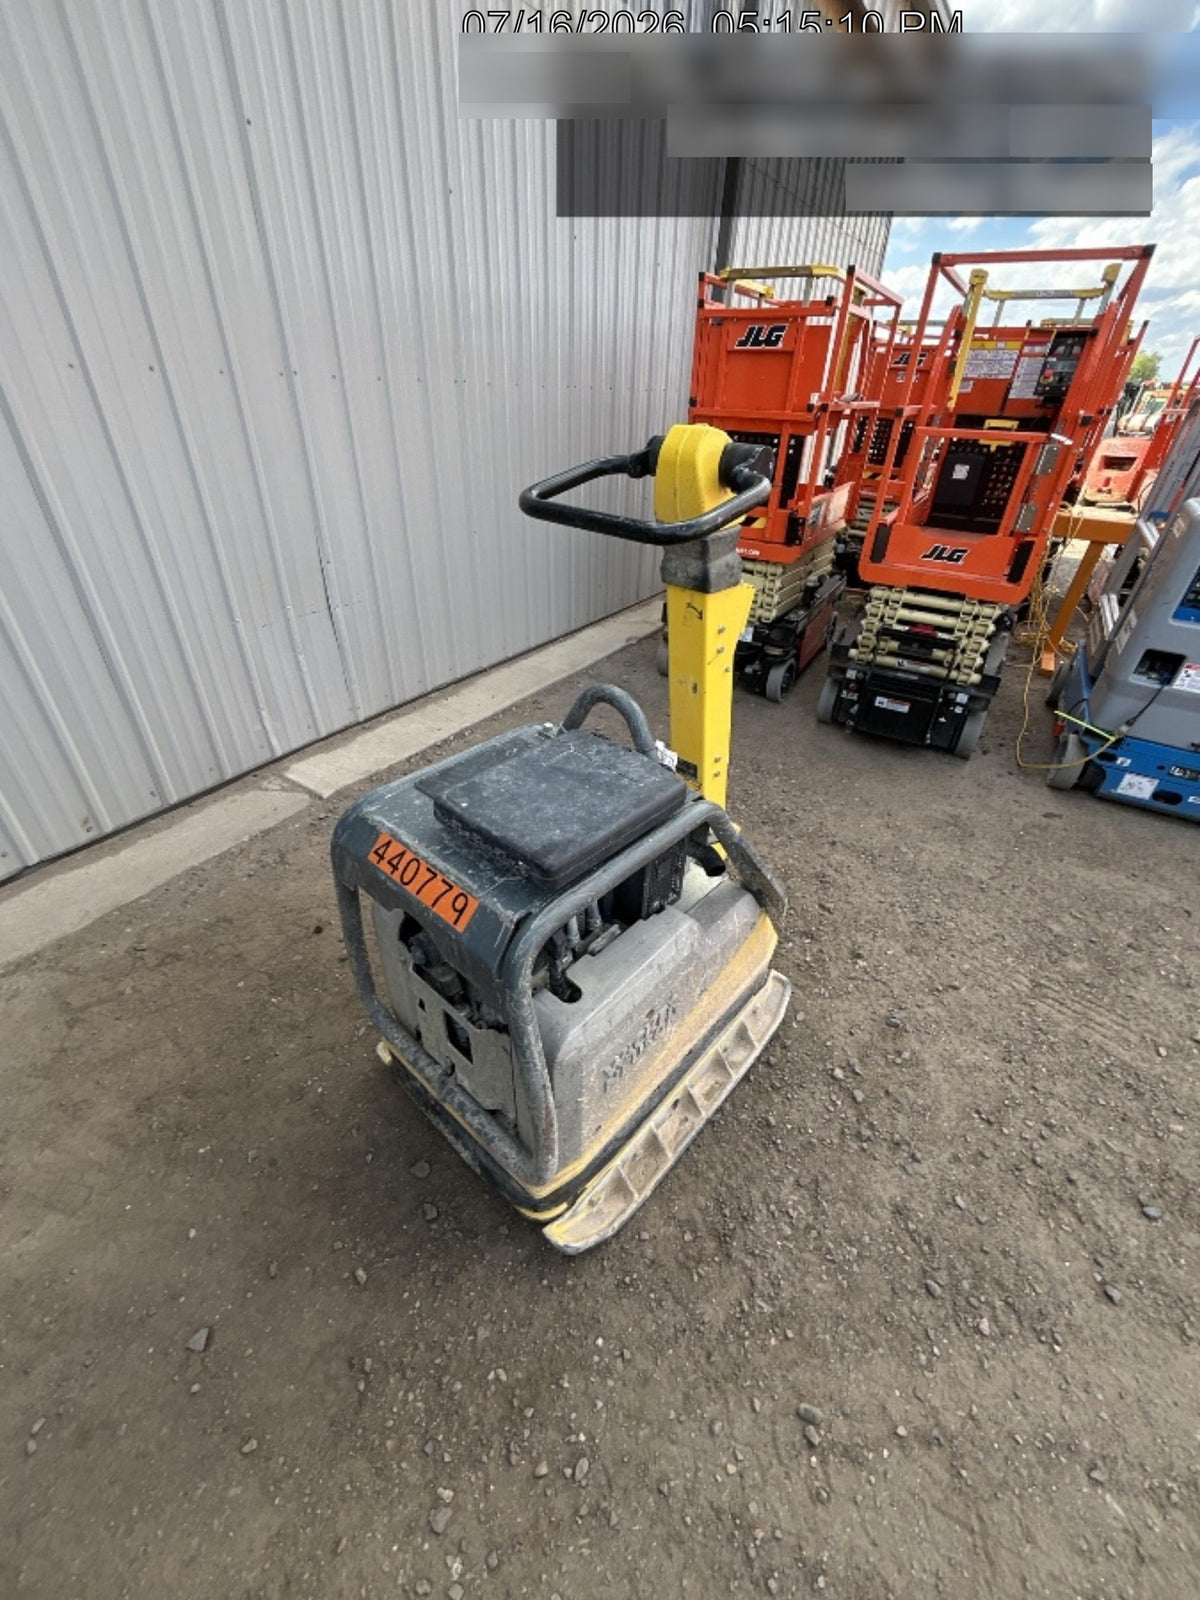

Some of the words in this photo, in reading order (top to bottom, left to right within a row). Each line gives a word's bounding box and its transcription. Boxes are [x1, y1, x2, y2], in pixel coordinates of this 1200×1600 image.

[735, 323, 789, 349] JLG
[919, 544, 971, 564] JLG
[373, 840, 469, 926] 440779
